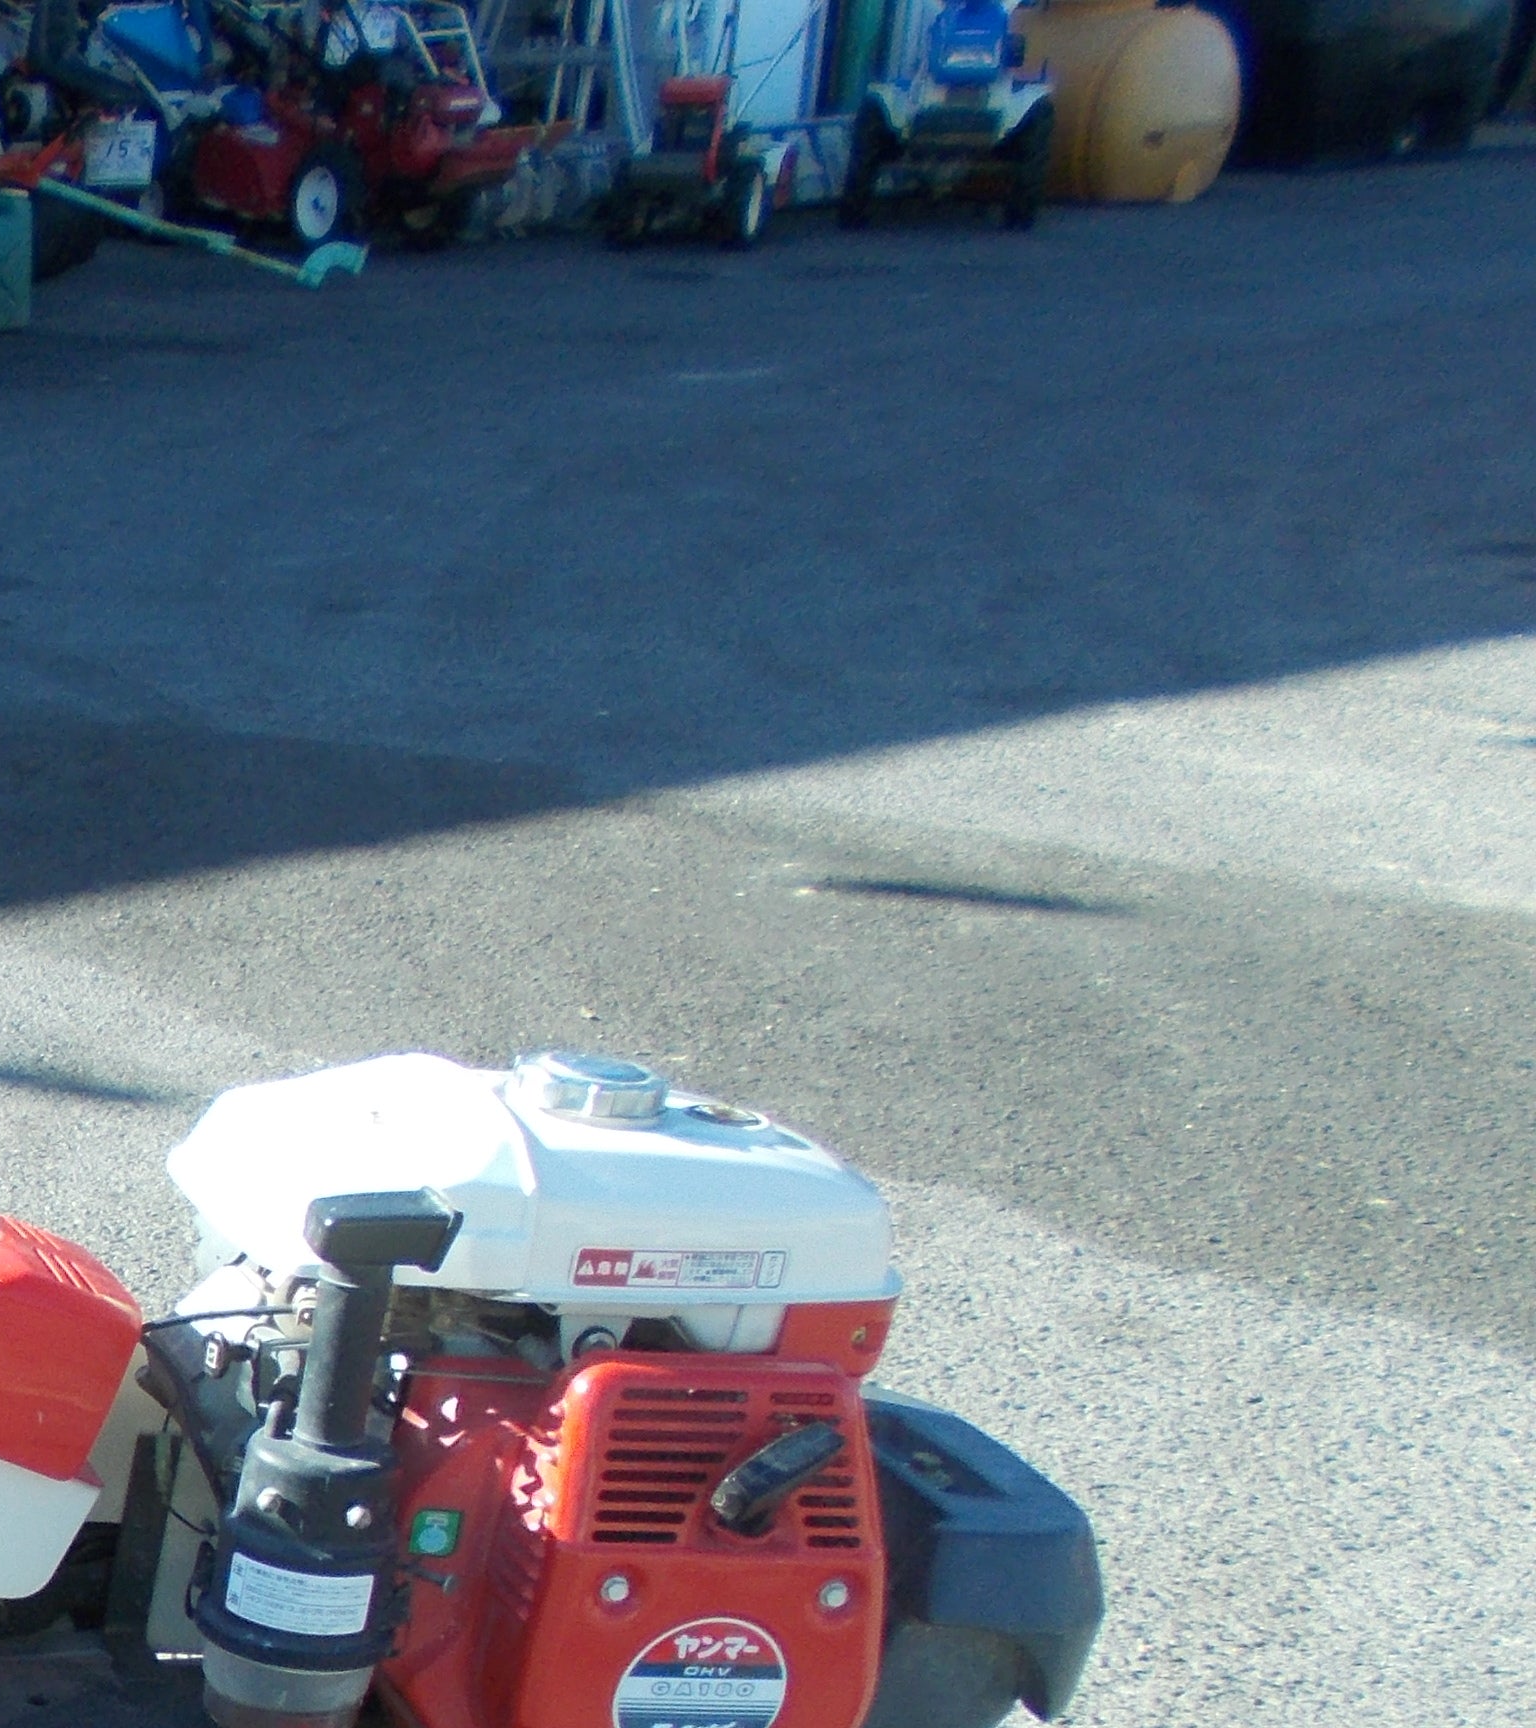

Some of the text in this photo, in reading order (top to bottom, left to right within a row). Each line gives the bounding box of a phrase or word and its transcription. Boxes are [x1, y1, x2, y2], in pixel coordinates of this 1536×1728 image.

[674, 1634, 760, 1660] ヤンマー
[683, 1665, 732, 1677] OHV
[651, 1681, 756, 1697] GA180
